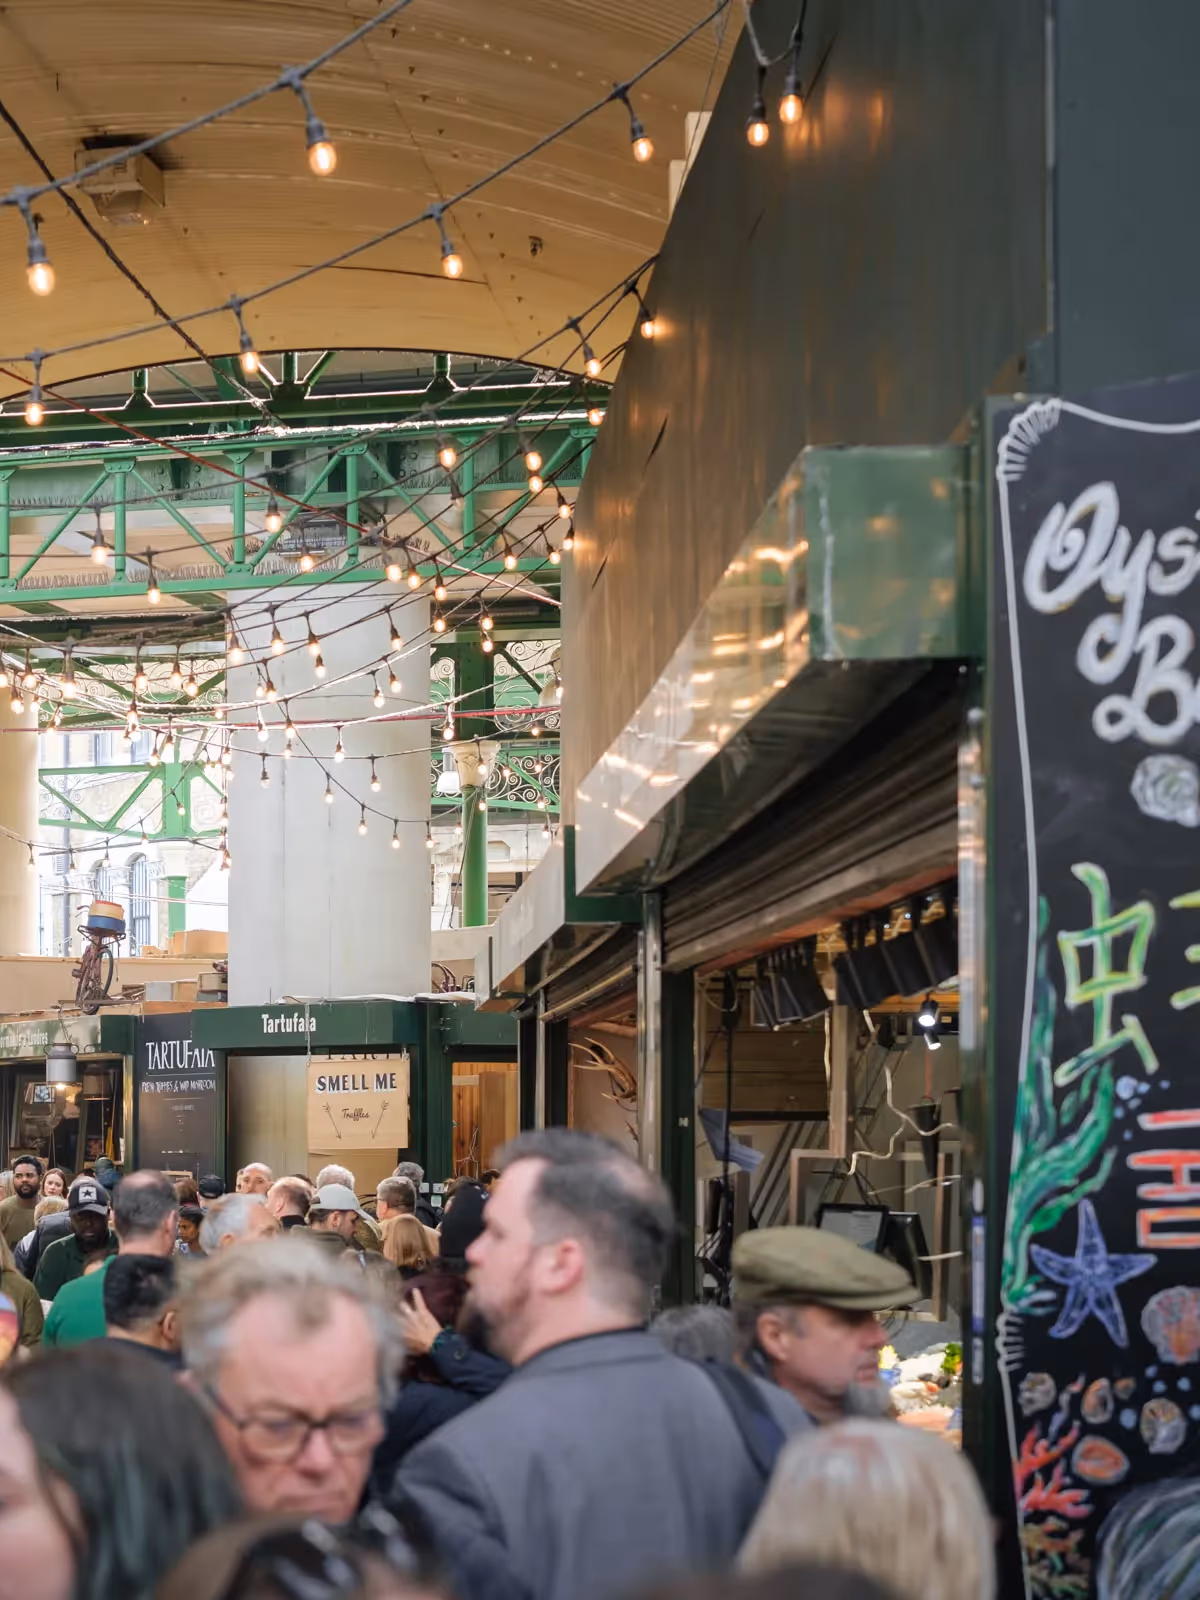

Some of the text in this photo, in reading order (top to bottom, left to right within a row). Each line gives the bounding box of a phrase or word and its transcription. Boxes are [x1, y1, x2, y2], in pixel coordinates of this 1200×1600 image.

[1023, 480, 1200, 684] Oys
[1092, 614, 1200, 746] B
[316, 1072, 398, 1094] SMELL ME
[341, 1107, 370, 1122] Truffles
